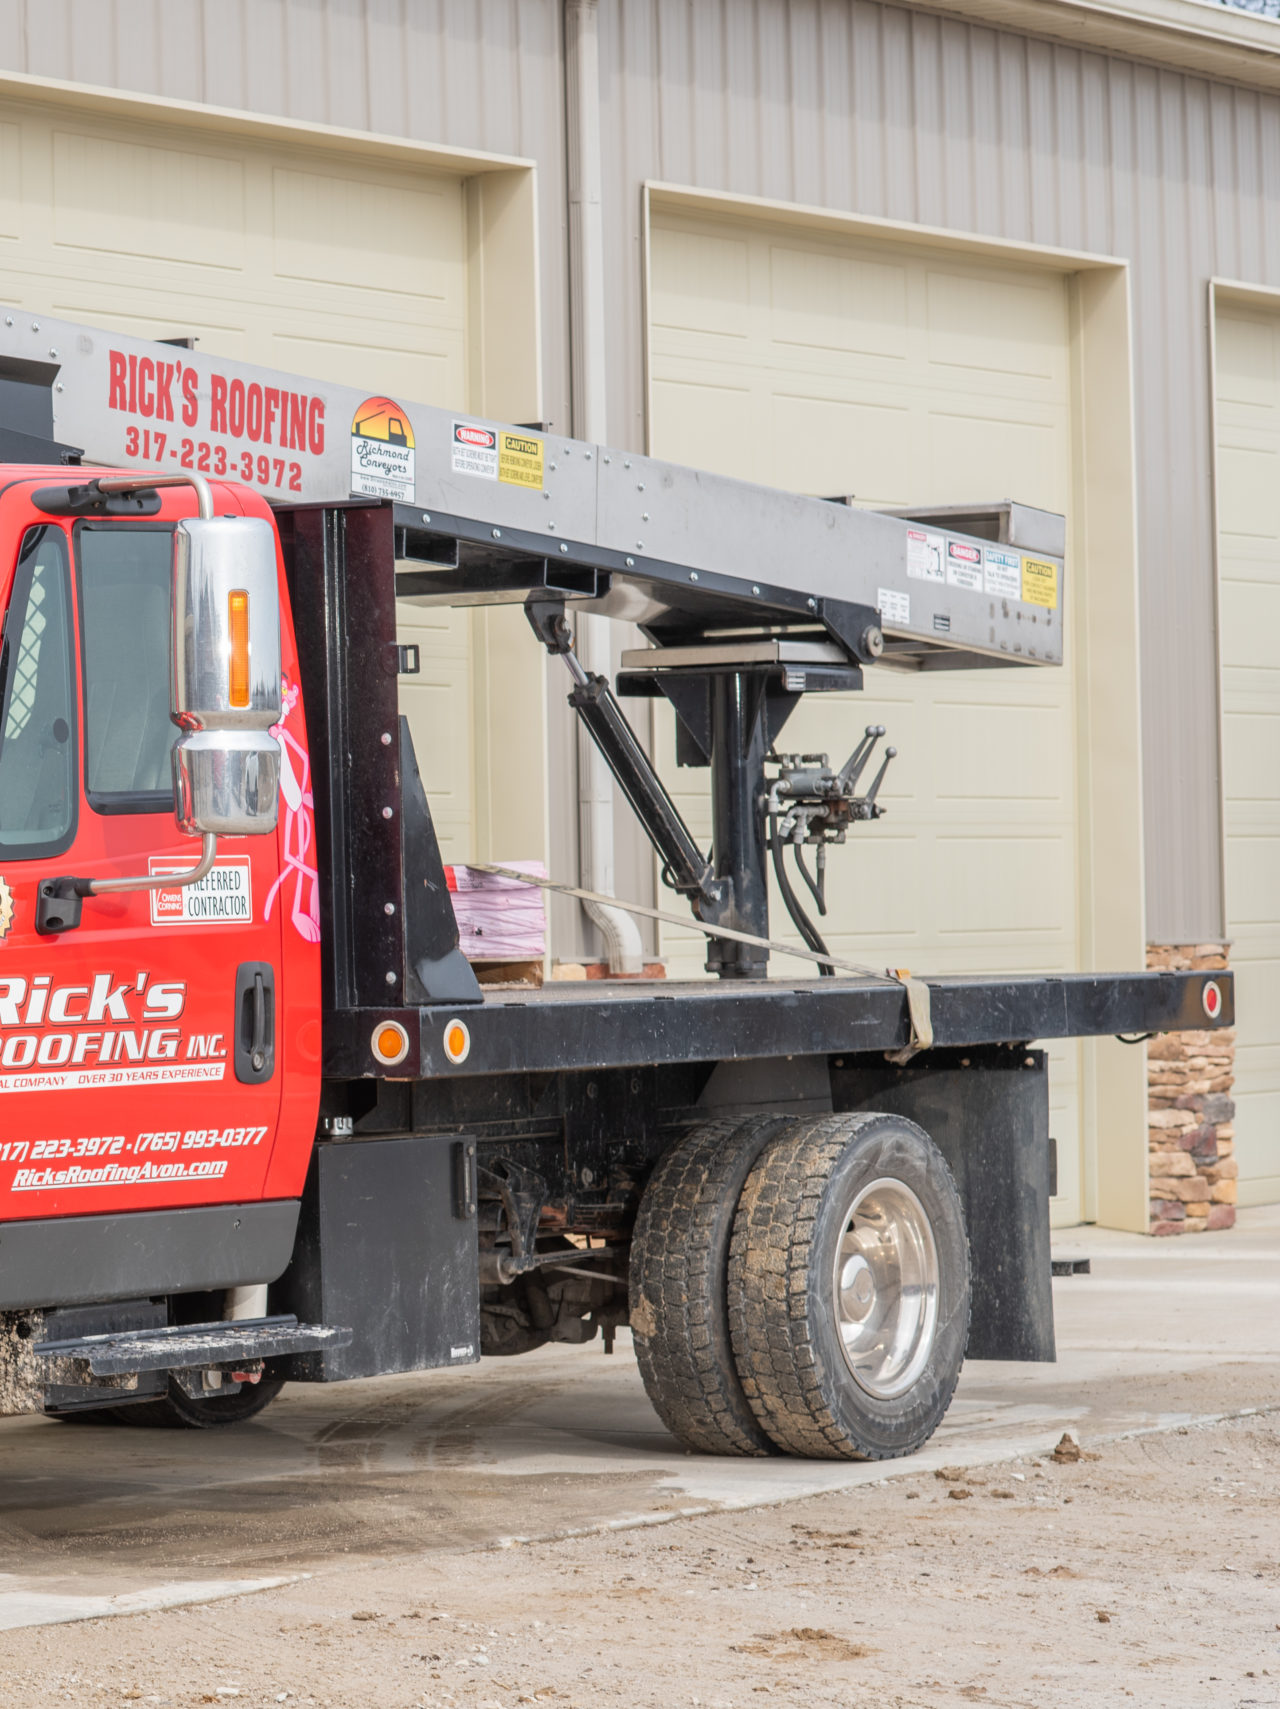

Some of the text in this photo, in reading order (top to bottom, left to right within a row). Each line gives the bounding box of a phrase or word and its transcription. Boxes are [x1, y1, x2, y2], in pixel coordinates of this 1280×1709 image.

[108, 349, 325, 456] RICK'S ROOFING
[460, 428, 490, 446] WARNING
[506, 437, 537, 455] CAUTION
[125, 425, 302, 493] 317-223-3972
[356, 440, 410, 461] Richmond
[360, 454, 407, 476] Conveyors
[1027, 562, 1052, 577] CAUTION
[188, 895, 247, 917] CONTRACTOR
[186, 1034, 227, 1058] INC.
[13, 1075, 68, 1089] COMPANY
[78, 1072, 107, 1084] OVER
[108, 1071, 123, 1083] 30
[125, 1069, 159, 1082] YEARS
[162, 1066, 222, 1080] EXPERIENCE
[30, 1136, 125, 1160] 223-3972
[133, 1131, 181, 1155] (765)
[181, 1126, 268, 1150] 993-0377
[12, 1160, 228, 1188] RicksRoofingAvon.com
